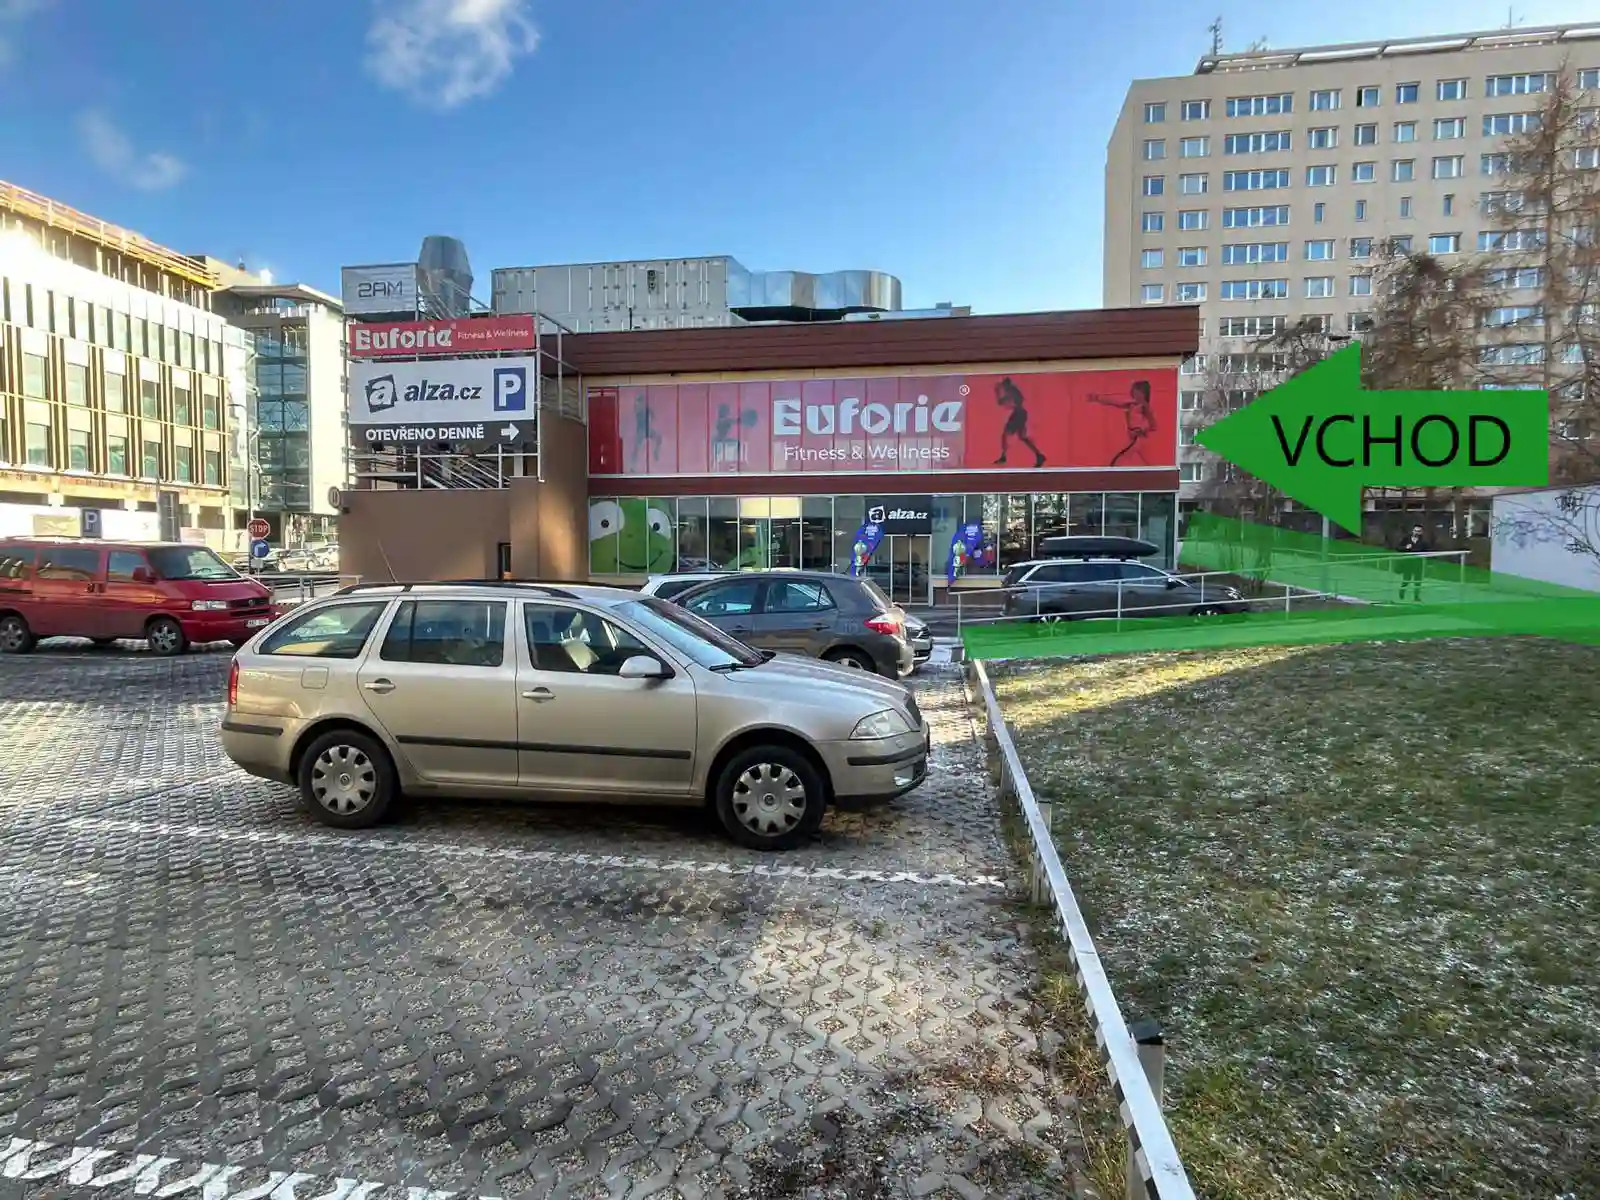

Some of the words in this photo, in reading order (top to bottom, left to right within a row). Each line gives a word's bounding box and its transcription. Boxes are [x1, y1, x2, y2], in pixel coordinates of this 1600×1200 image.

[457, 331, 485, 340] Fitness
[493, 329, 529, 338] Wellness
[404, 379, 483, 402] alza.cz
[499, 373, 522, 408] P
[365, 426, 436, 441] OTEVŘENO
[438, 424, 485, 440] DENNĚ
[784, 446, 846, 461] Fitness
[851, 446, 864, 461] &
[868, 444, 950, 461] Wellness
[887, 508, 928, 520] alza.cz
[249, 524, 269, 533] STOP
